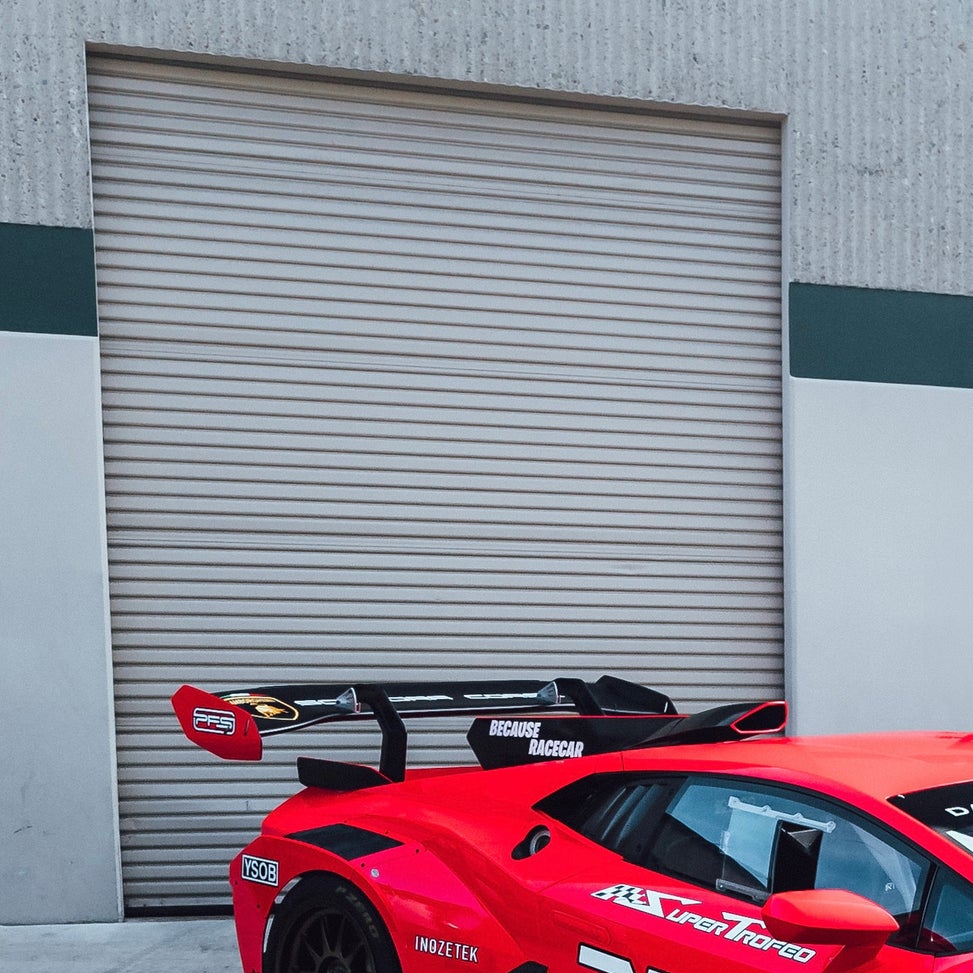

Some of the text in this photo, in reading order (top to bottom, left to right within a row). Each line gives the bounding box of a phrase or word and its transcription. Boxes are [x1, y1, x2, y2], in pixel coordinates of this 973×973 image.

[193, 711, 235, 731] PFS
[489, 719, 542, 739] BECAUSE
[528, 738, 585, 758] RACECAR
[244, 859, 277, 884] YSOB
[414, 935, 479, 963] INOZETEK
